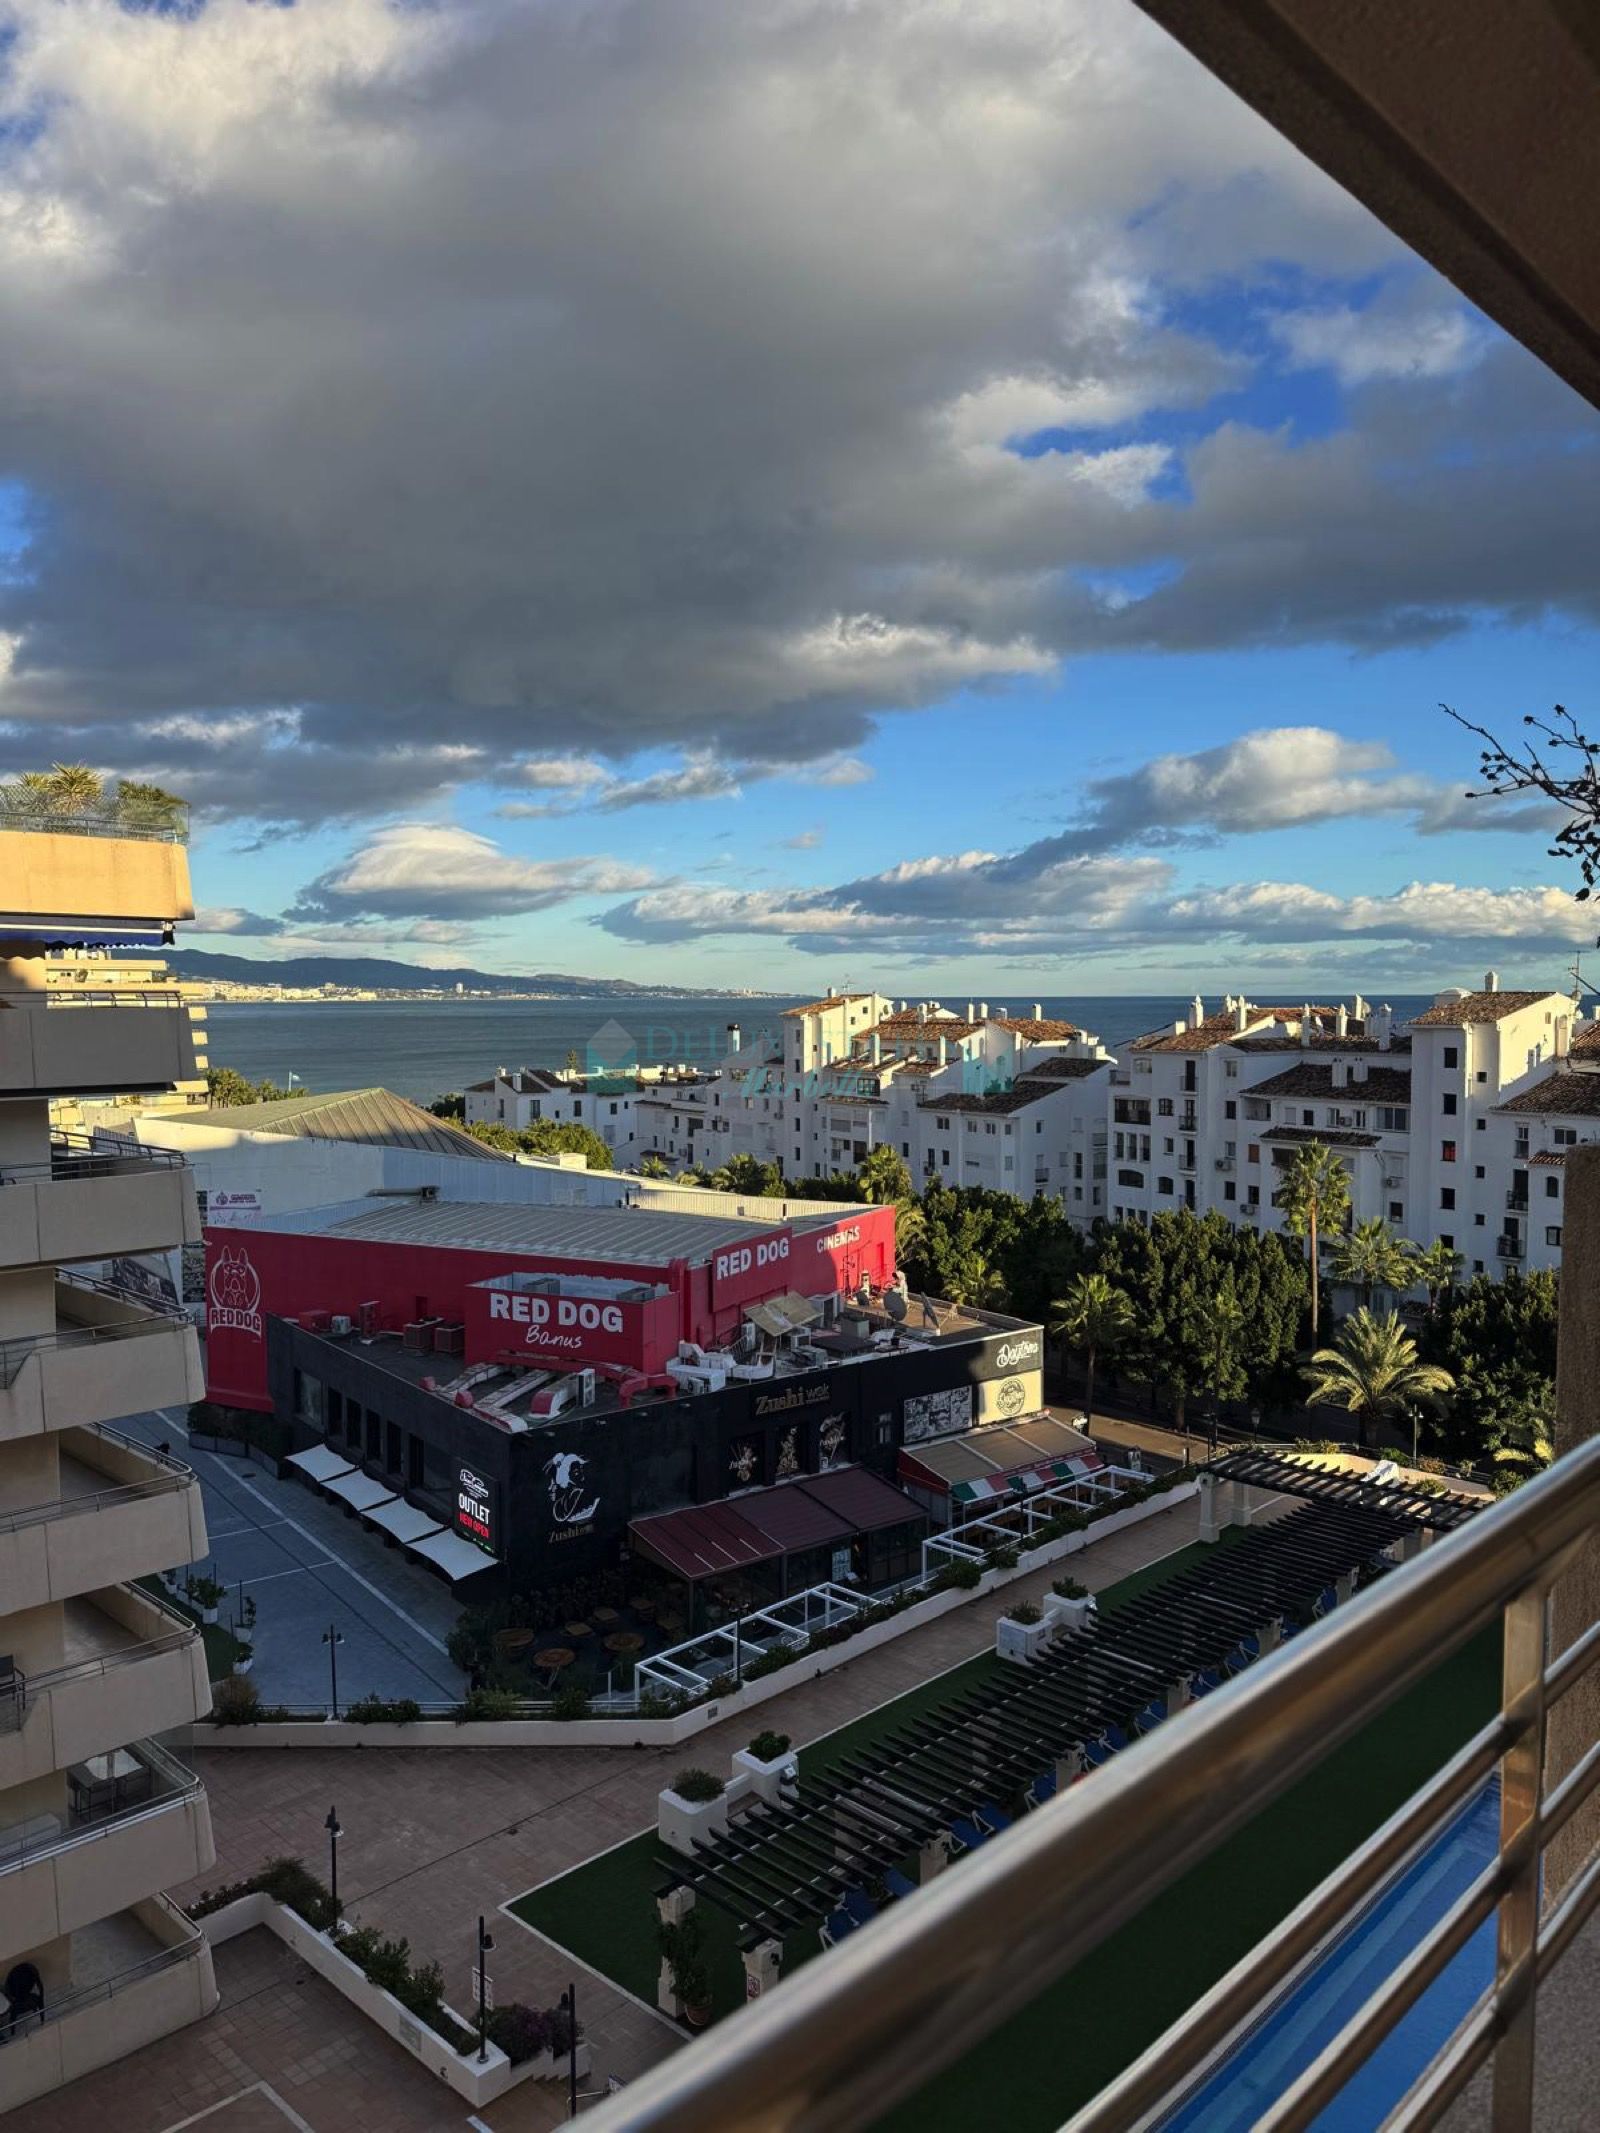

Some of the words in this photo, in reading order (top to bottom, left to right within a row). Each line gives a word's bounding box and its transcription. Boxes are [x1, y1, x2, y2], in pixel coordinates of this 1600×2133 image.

[817, 1226, 860, 1253] CINEMAS
[717, 1248, 752, 1281] RED
[758, 1237, 790, 1267] DOG
[490, 1293, 551, 1325] RED
[558, 1300, 623, 1333] DOG
[458, 1493, 490, 1525] OUTLET
